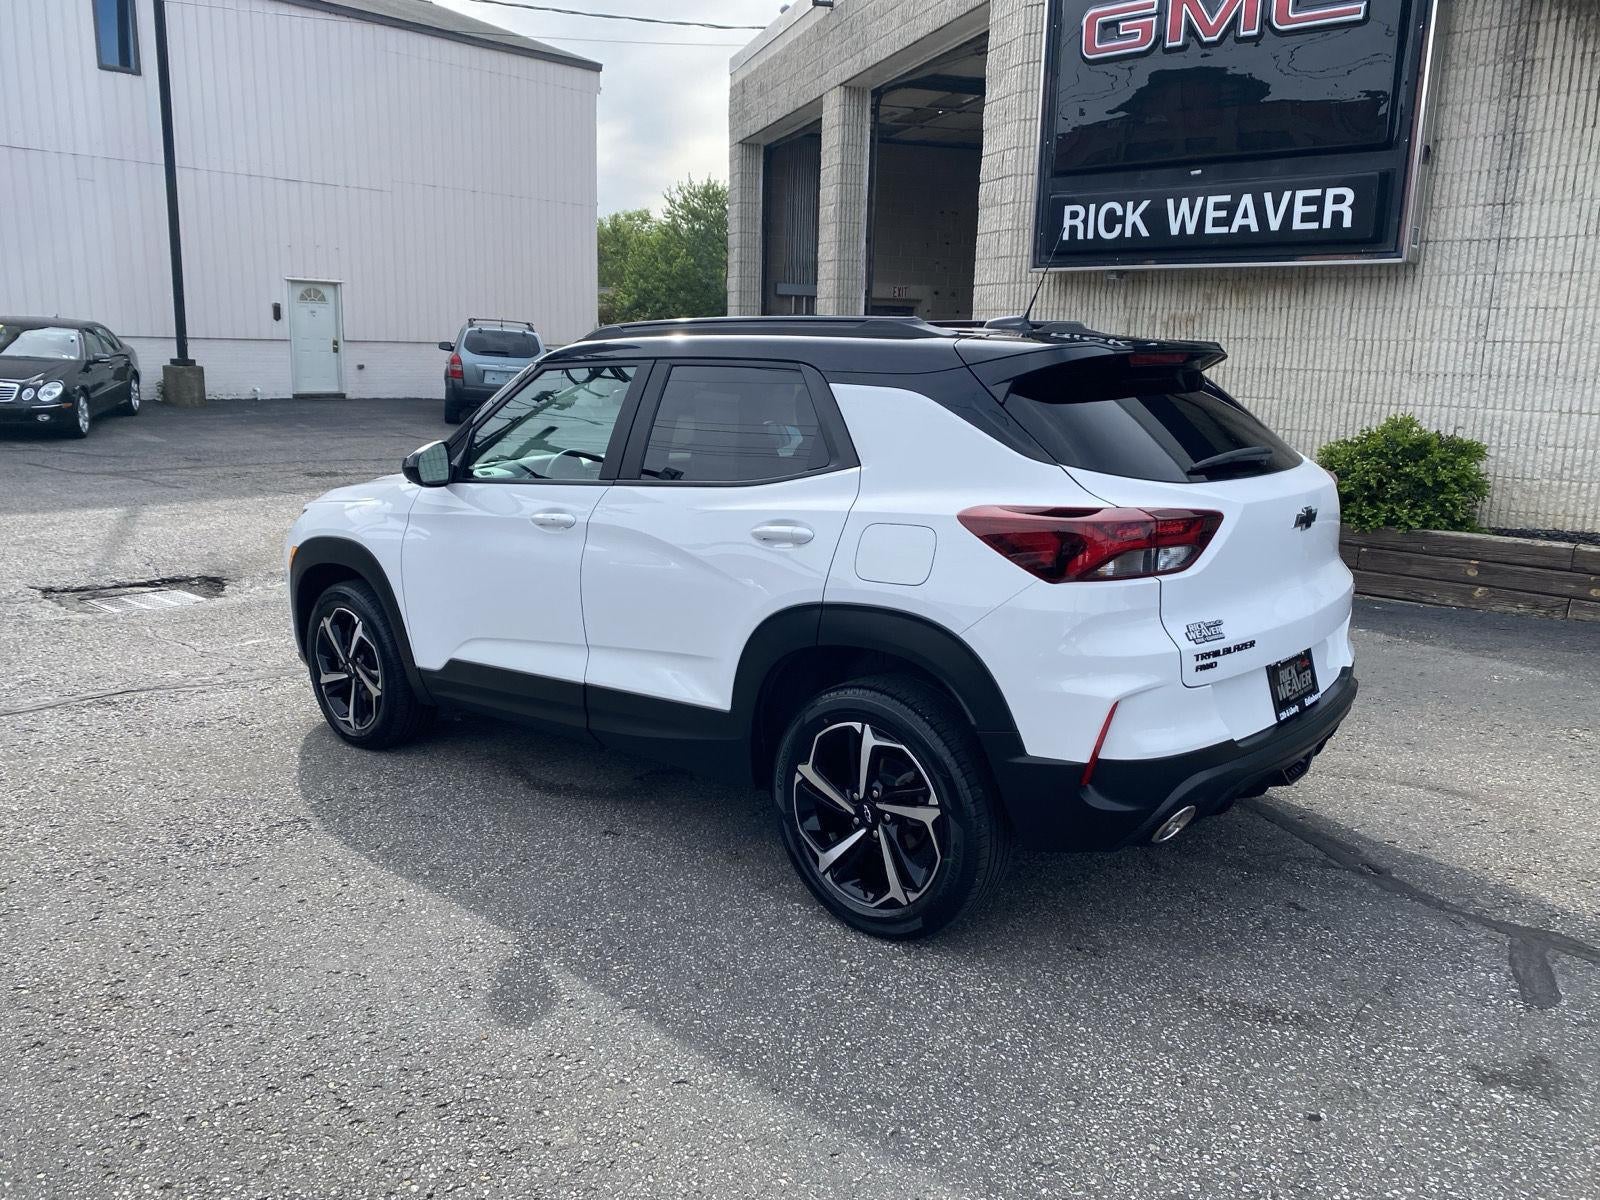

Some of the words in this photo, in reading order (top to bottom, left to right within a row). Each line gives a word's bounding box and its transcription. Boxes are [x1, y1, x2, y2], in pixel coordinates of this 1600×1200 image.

[1081, 0, 1368, 60] GMC
[1062, 199, 1151, 241] RICK
[1166, 186, 1355, 236] WEAVER
[892, 286, 909, 298] EXIT
[1194, 640, 1256, 662] TRAILBLAZER
[1277, 669, 1313, 701] WEAVER
[1280, 664, 1298, 684] RICK
